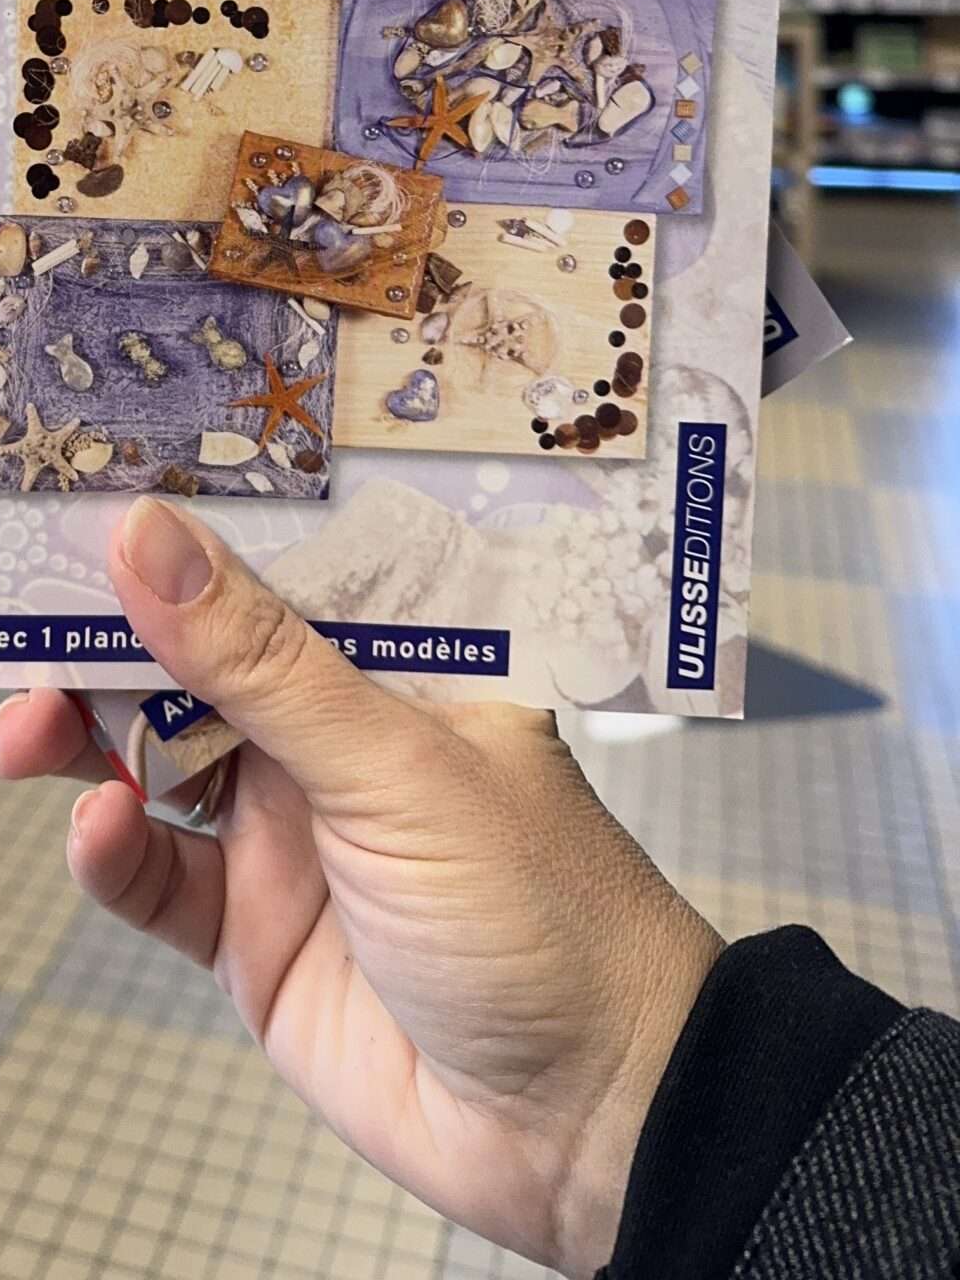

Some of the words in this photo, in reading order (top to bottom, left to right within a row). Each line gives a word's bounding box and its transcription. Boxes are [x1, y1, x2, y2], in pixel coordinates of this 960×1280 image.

[677, 433, 716, 680] ULISSEDITIONS
[41, 626, 51, 648] 1
[372, 636, 496, 662] modèles
